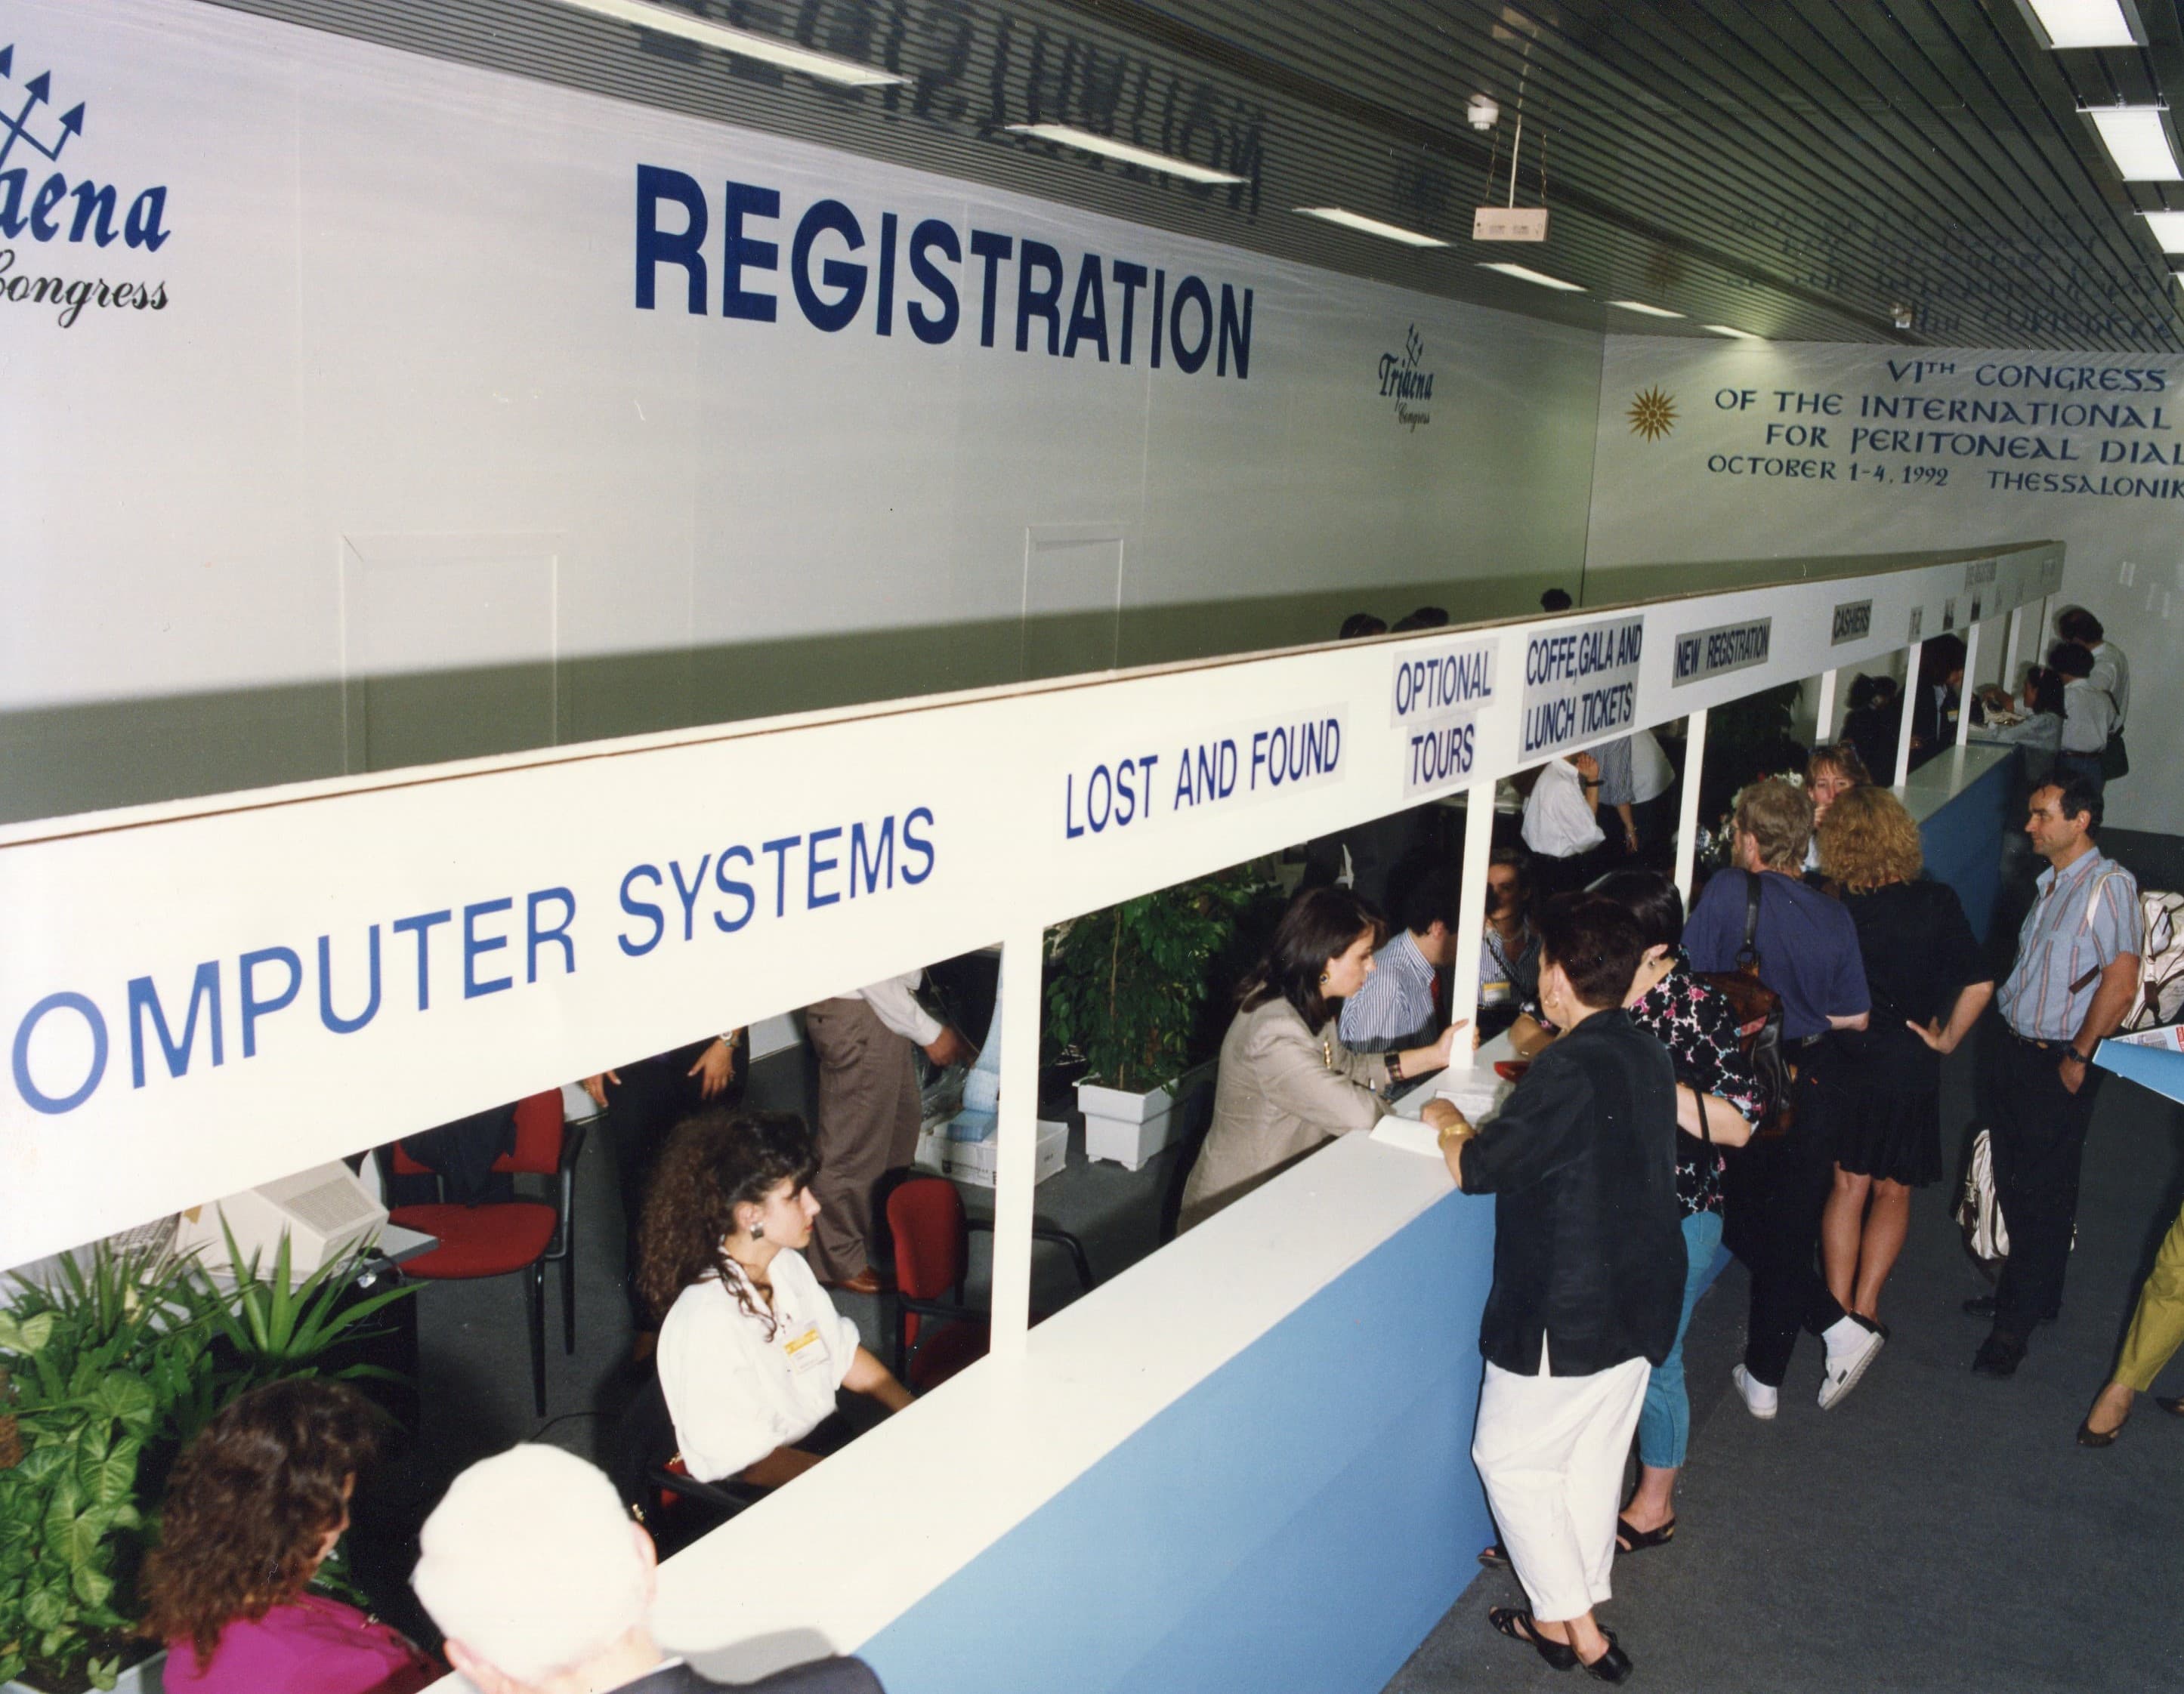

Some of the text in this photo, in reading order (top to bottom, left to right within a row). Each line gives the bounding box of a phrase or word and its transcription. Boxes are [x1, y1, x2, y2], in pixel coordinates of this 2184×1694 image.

[635, 163, 1255, 381] REGISTRATION
[1975, 363, 2167, 393] CONGRESS
[1715, 387, 2172, 430] OF THE INTERNATIONAL
[1765, 423, 1830, 449] FOR
[1850, 427, 2081, 461] PERITONEAL
[1707, 454, 1837, 480] OCTOBER
[1901, 464, 1949, 487] 1992
[1616, 623, 1643, 668] AND
[1833, 605, 1871, 640] CASHIERS
[1676, 624, 1771, 678] NEW REGISTRATION
[1396, 651, 1492, 715] OPTIONAL
[1524, 681, 1633, 752] LUNCH TICKETS
[1066, 718, 1340, 839] LOST AND FOUND
[1411, 723, 1475, 785] TOURS
[617, 806, 935, 957] SYSTEMS
